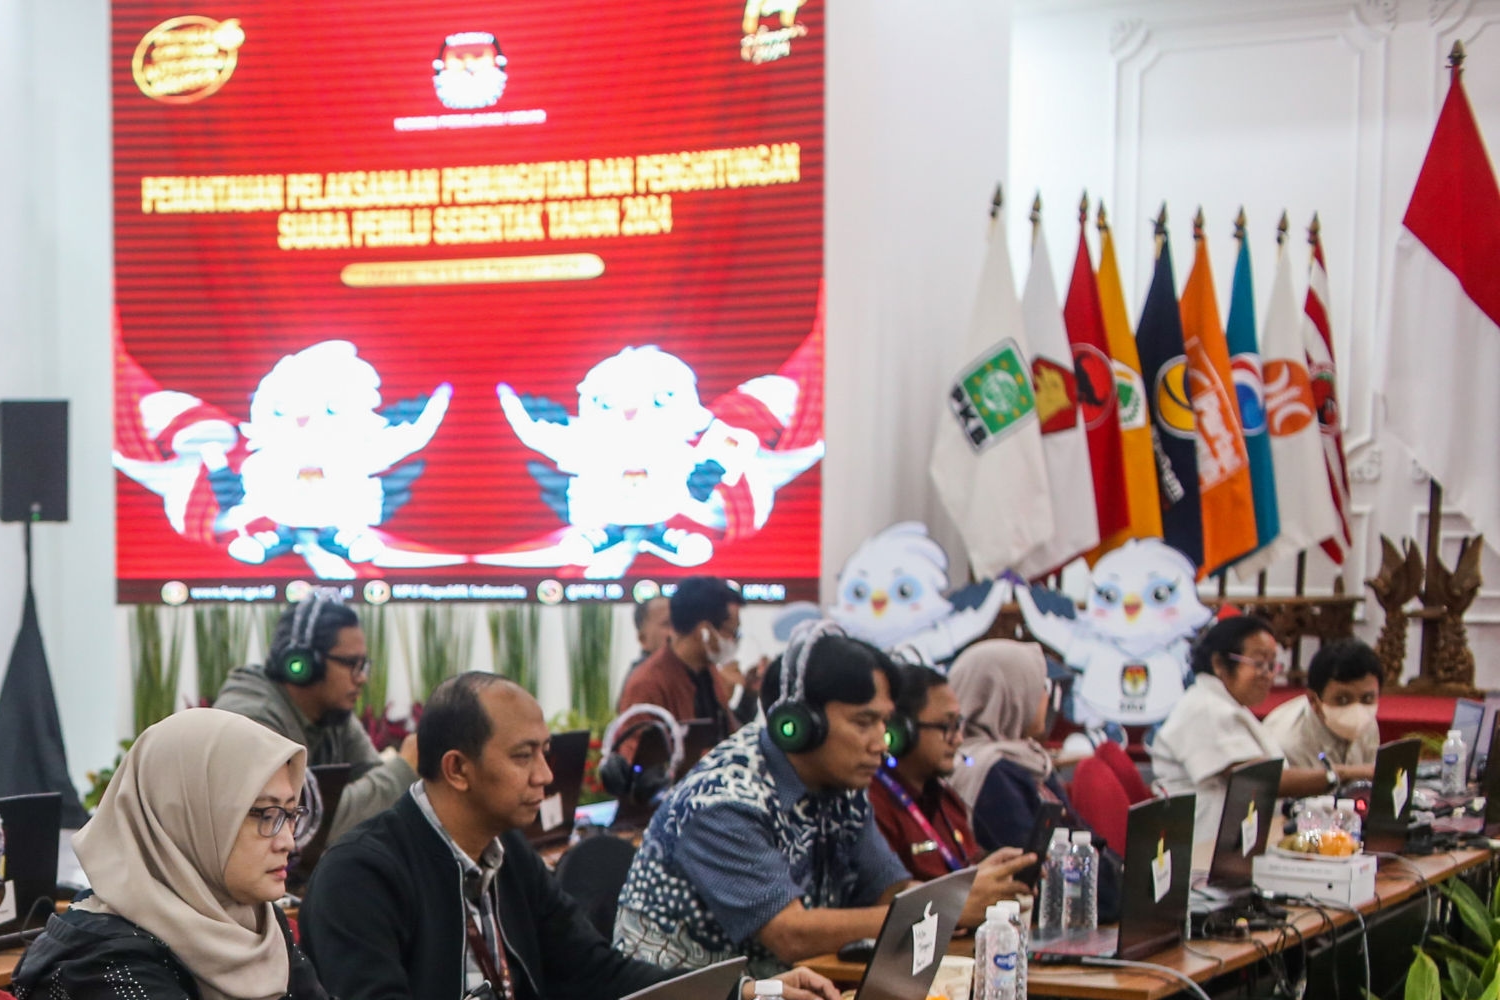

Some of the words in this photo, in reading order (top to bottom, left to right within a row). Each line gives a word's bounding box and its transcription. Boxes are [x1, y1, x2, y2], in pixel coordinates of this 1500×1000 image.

[286, 168, 440, 211] PELAKSANAAN
[588, 156, 635, 198] DAN
[277, 211, 351, 250] SUARA
[352, 207, 432, 248] PEMILU
[432, 202, 545, 245] SERENTAK
[546, 197, 621, 240] TAHUN
[621, 193, 673, 236] 2024
[951, 385, 988, 446] PKB
[469, 584, 527, 599] Indonesia
